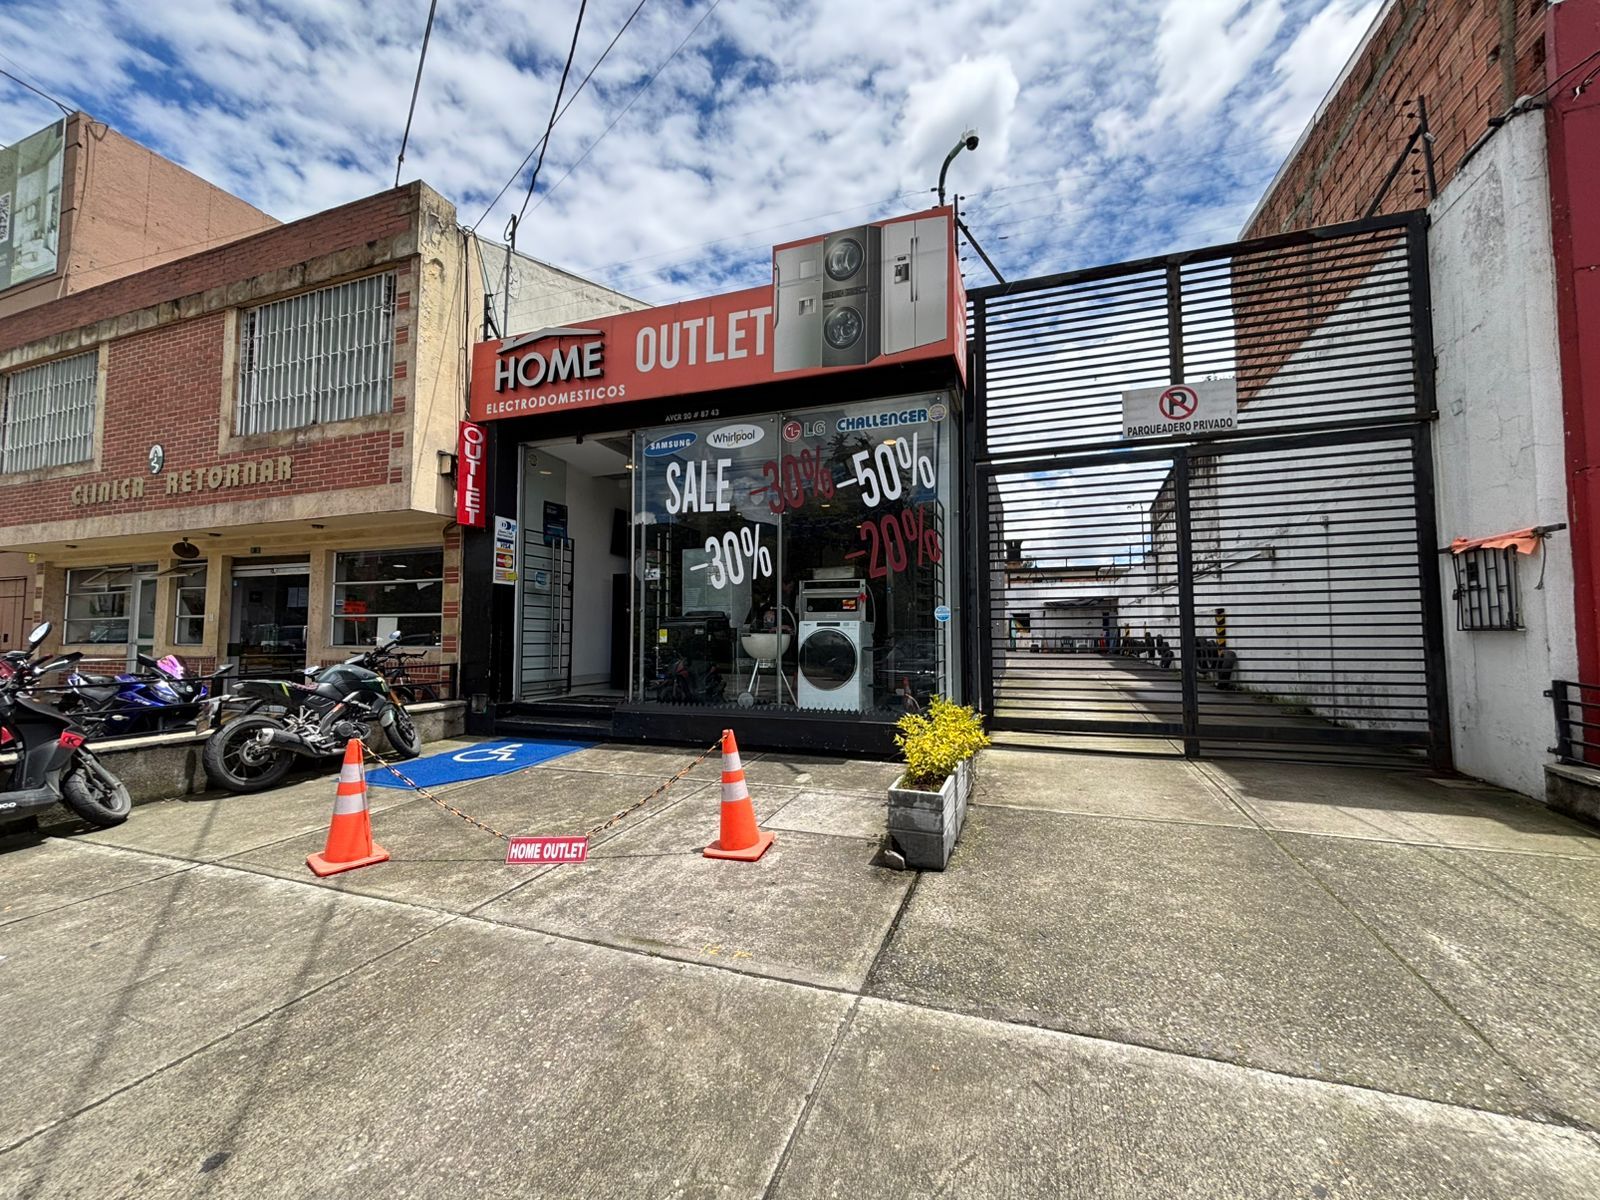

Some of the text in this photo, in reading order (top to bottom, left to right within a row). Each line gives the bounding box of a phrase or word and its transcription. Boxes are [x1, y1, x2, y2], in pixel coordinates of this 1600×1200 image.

[636, 306, 772, 373] OUTLET
[494, 340, 603, 392] HOME
[486, 384, 626, 415] ELECTRODOMESTICOS
[836, 407, 929, 432] CHALLENGER
[650, 438, 691, 451] SAMSUNG
[712, 429, 755, 446] Whirlpool
[803, 420, 826, 438] LG
[1127, 417, 1233, 437] PARQUEADERO PRIVADO
[71, 455, 293, 506] CLINICA RETORNAR
[463, 427, 484, 524] OUTLET
[665, 458, 732, 515] SALE
[836, 432, 936, 508] -50%
[689, 523, 773, 590] -30%
[844, 504, 941, 579] -20%
[509, 842, 586, 859] HOME OUTLET
